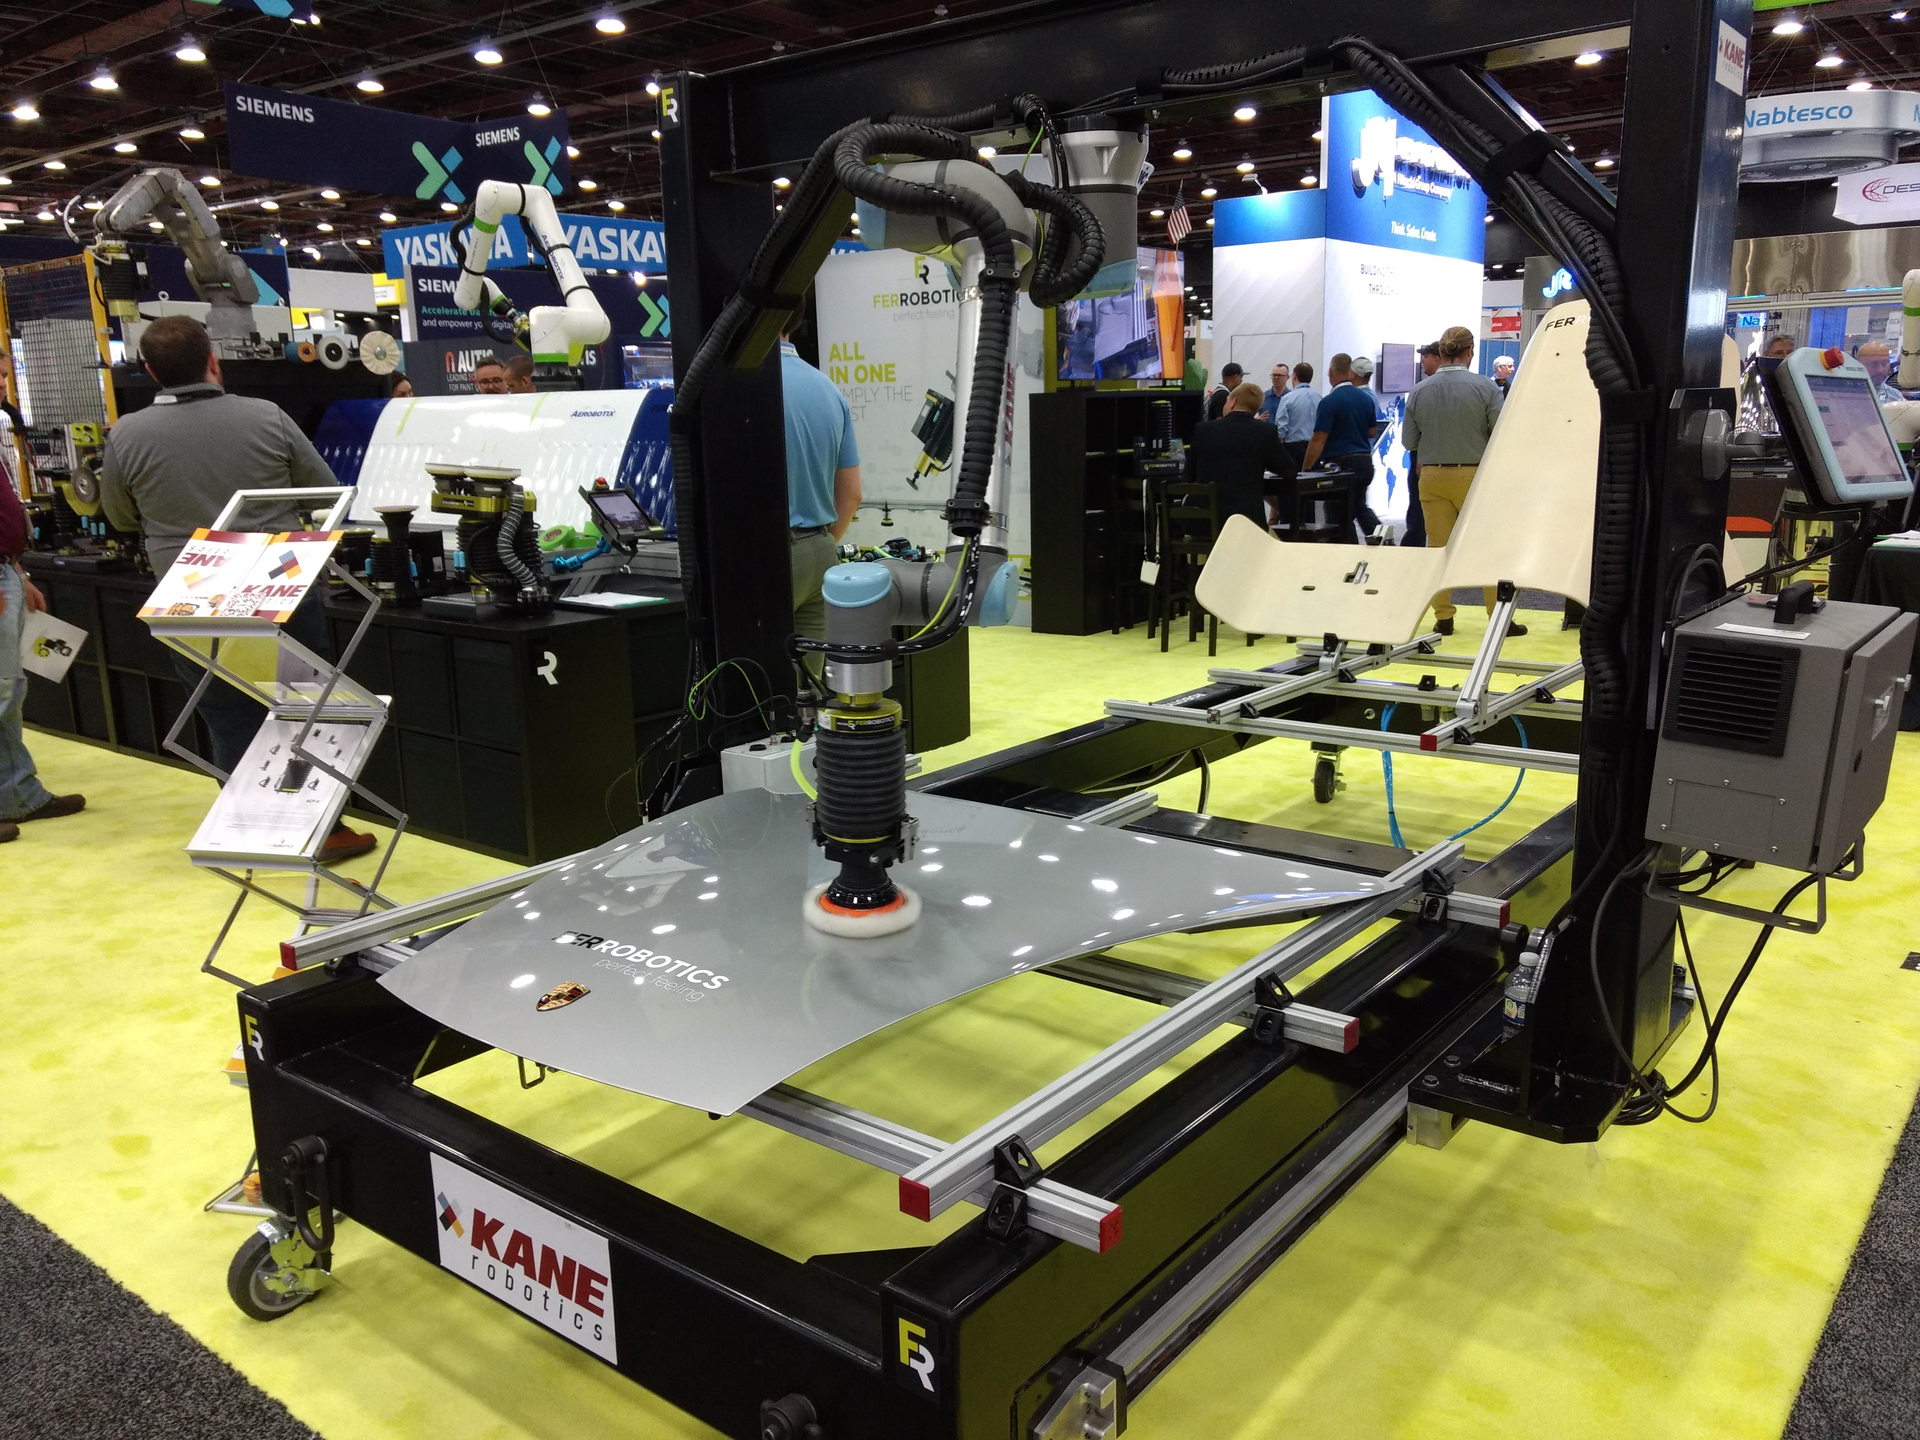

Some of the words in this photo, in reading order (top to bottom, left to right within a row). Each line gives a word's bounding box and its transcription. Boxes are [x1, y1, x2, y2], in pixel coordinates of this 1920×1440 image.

[1724, 39, 1745, 68] KANE
[236, 95, 314, 123] SIEMENS
[1745, 105, 1853, 128] Nabtesco
[476, 126, 520, 147] SIEMENS
[395, 224, 513, 265] YASKA
[562, 224, 664, 264] YASKA
[418, 278, 456, 293] SIEM
[421, 306, 469, 316] Accelerate
[893, 311, 923, 322] perfect
[925, 309, 955, 320] feeling
[422, 318, 437, 327] and
[438, 319, 473, 329] empower
[829, 342, 865, 362] ALL
[829, 366, 849, 385] IN
[854, 363, 896, 384] ONE
[448, 384, 459, 392] FOR
[460, 384, 474, 392] PAINT
[884, 385, 913, 402] THE
[851, 405, 867, 422] ST
[592, 958, 652, 979] perfect
[652, 974, 705, 1003] feeling
[471, 1208, 608, 1318] KANE
[471, 1254, 603, 1342] robotics
